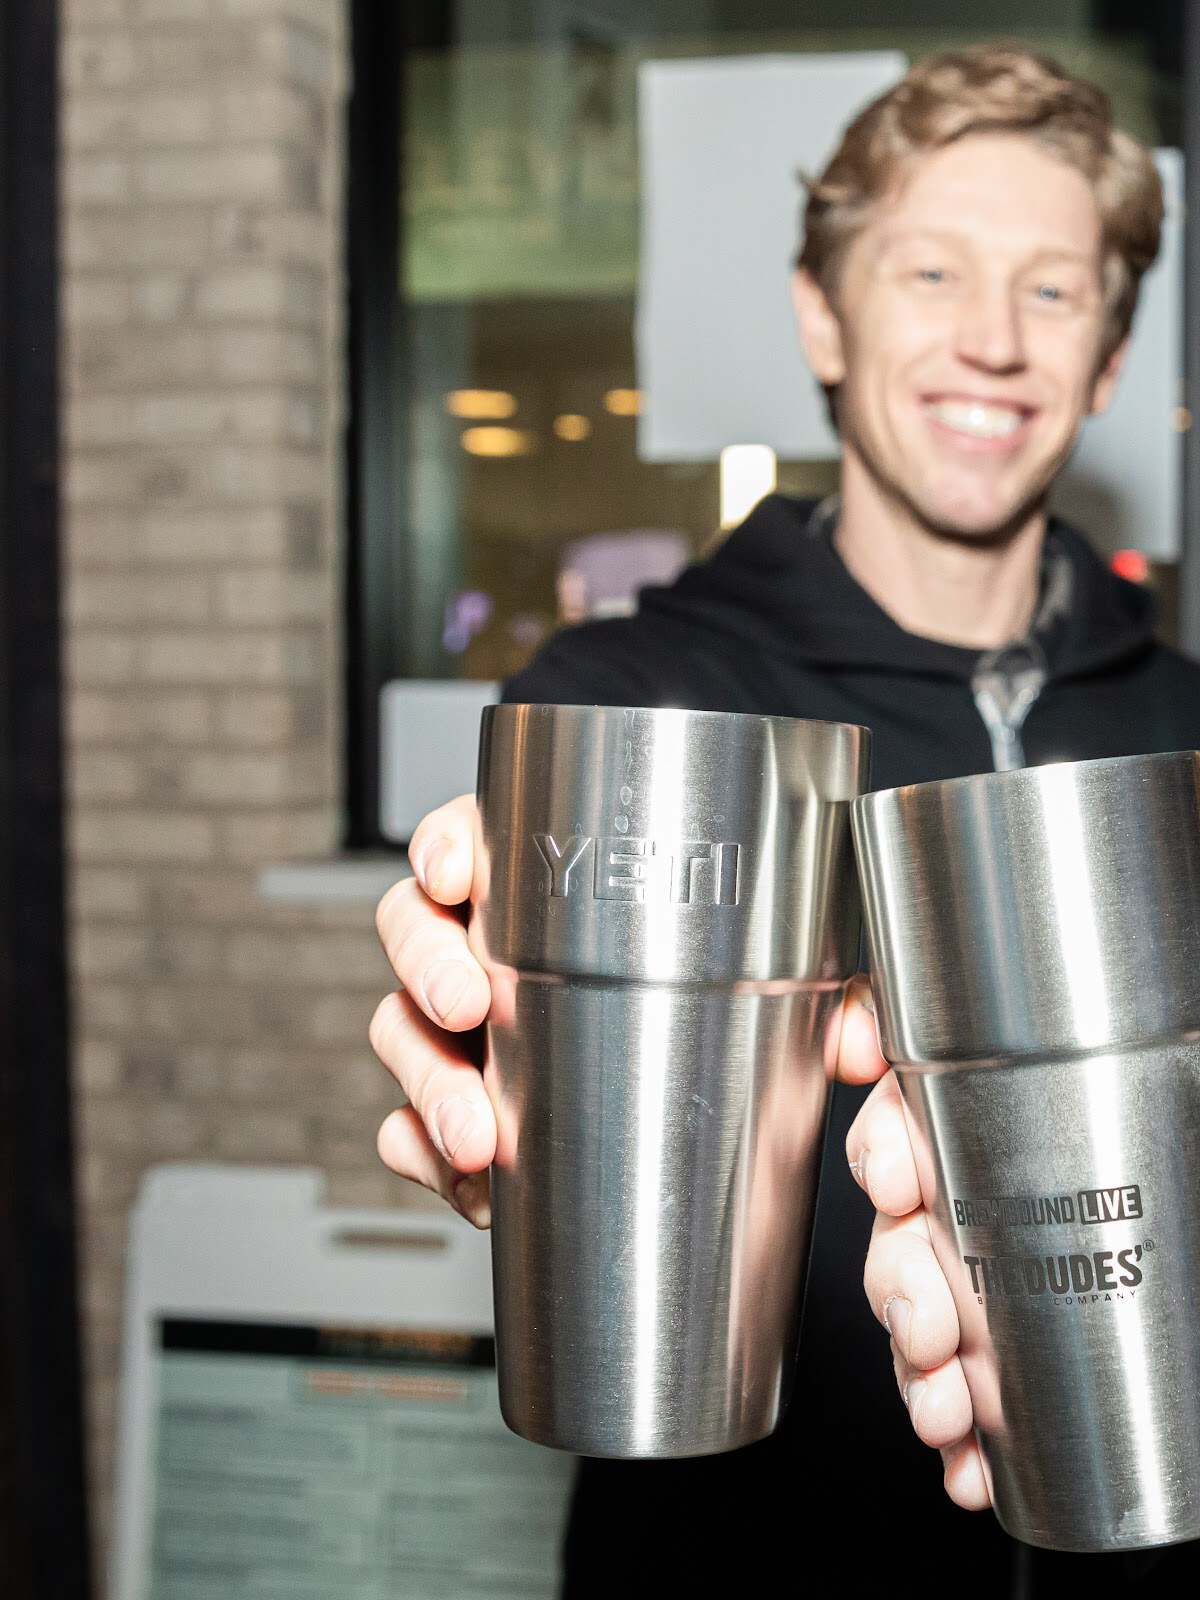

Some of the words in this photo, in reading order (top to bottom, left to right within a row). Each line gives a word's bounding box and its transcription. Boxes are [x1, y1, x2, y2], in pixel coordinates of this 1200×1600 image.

[533, 834, 741, 905] YETI
[953, 1196, 1075, 1227] BREWBOUND
[1079, 1186, 1142, 1224] LIVE
[963, 1255, 1023, 1297] THE
[1053, 1290, 1137, 1307] COMPANY
